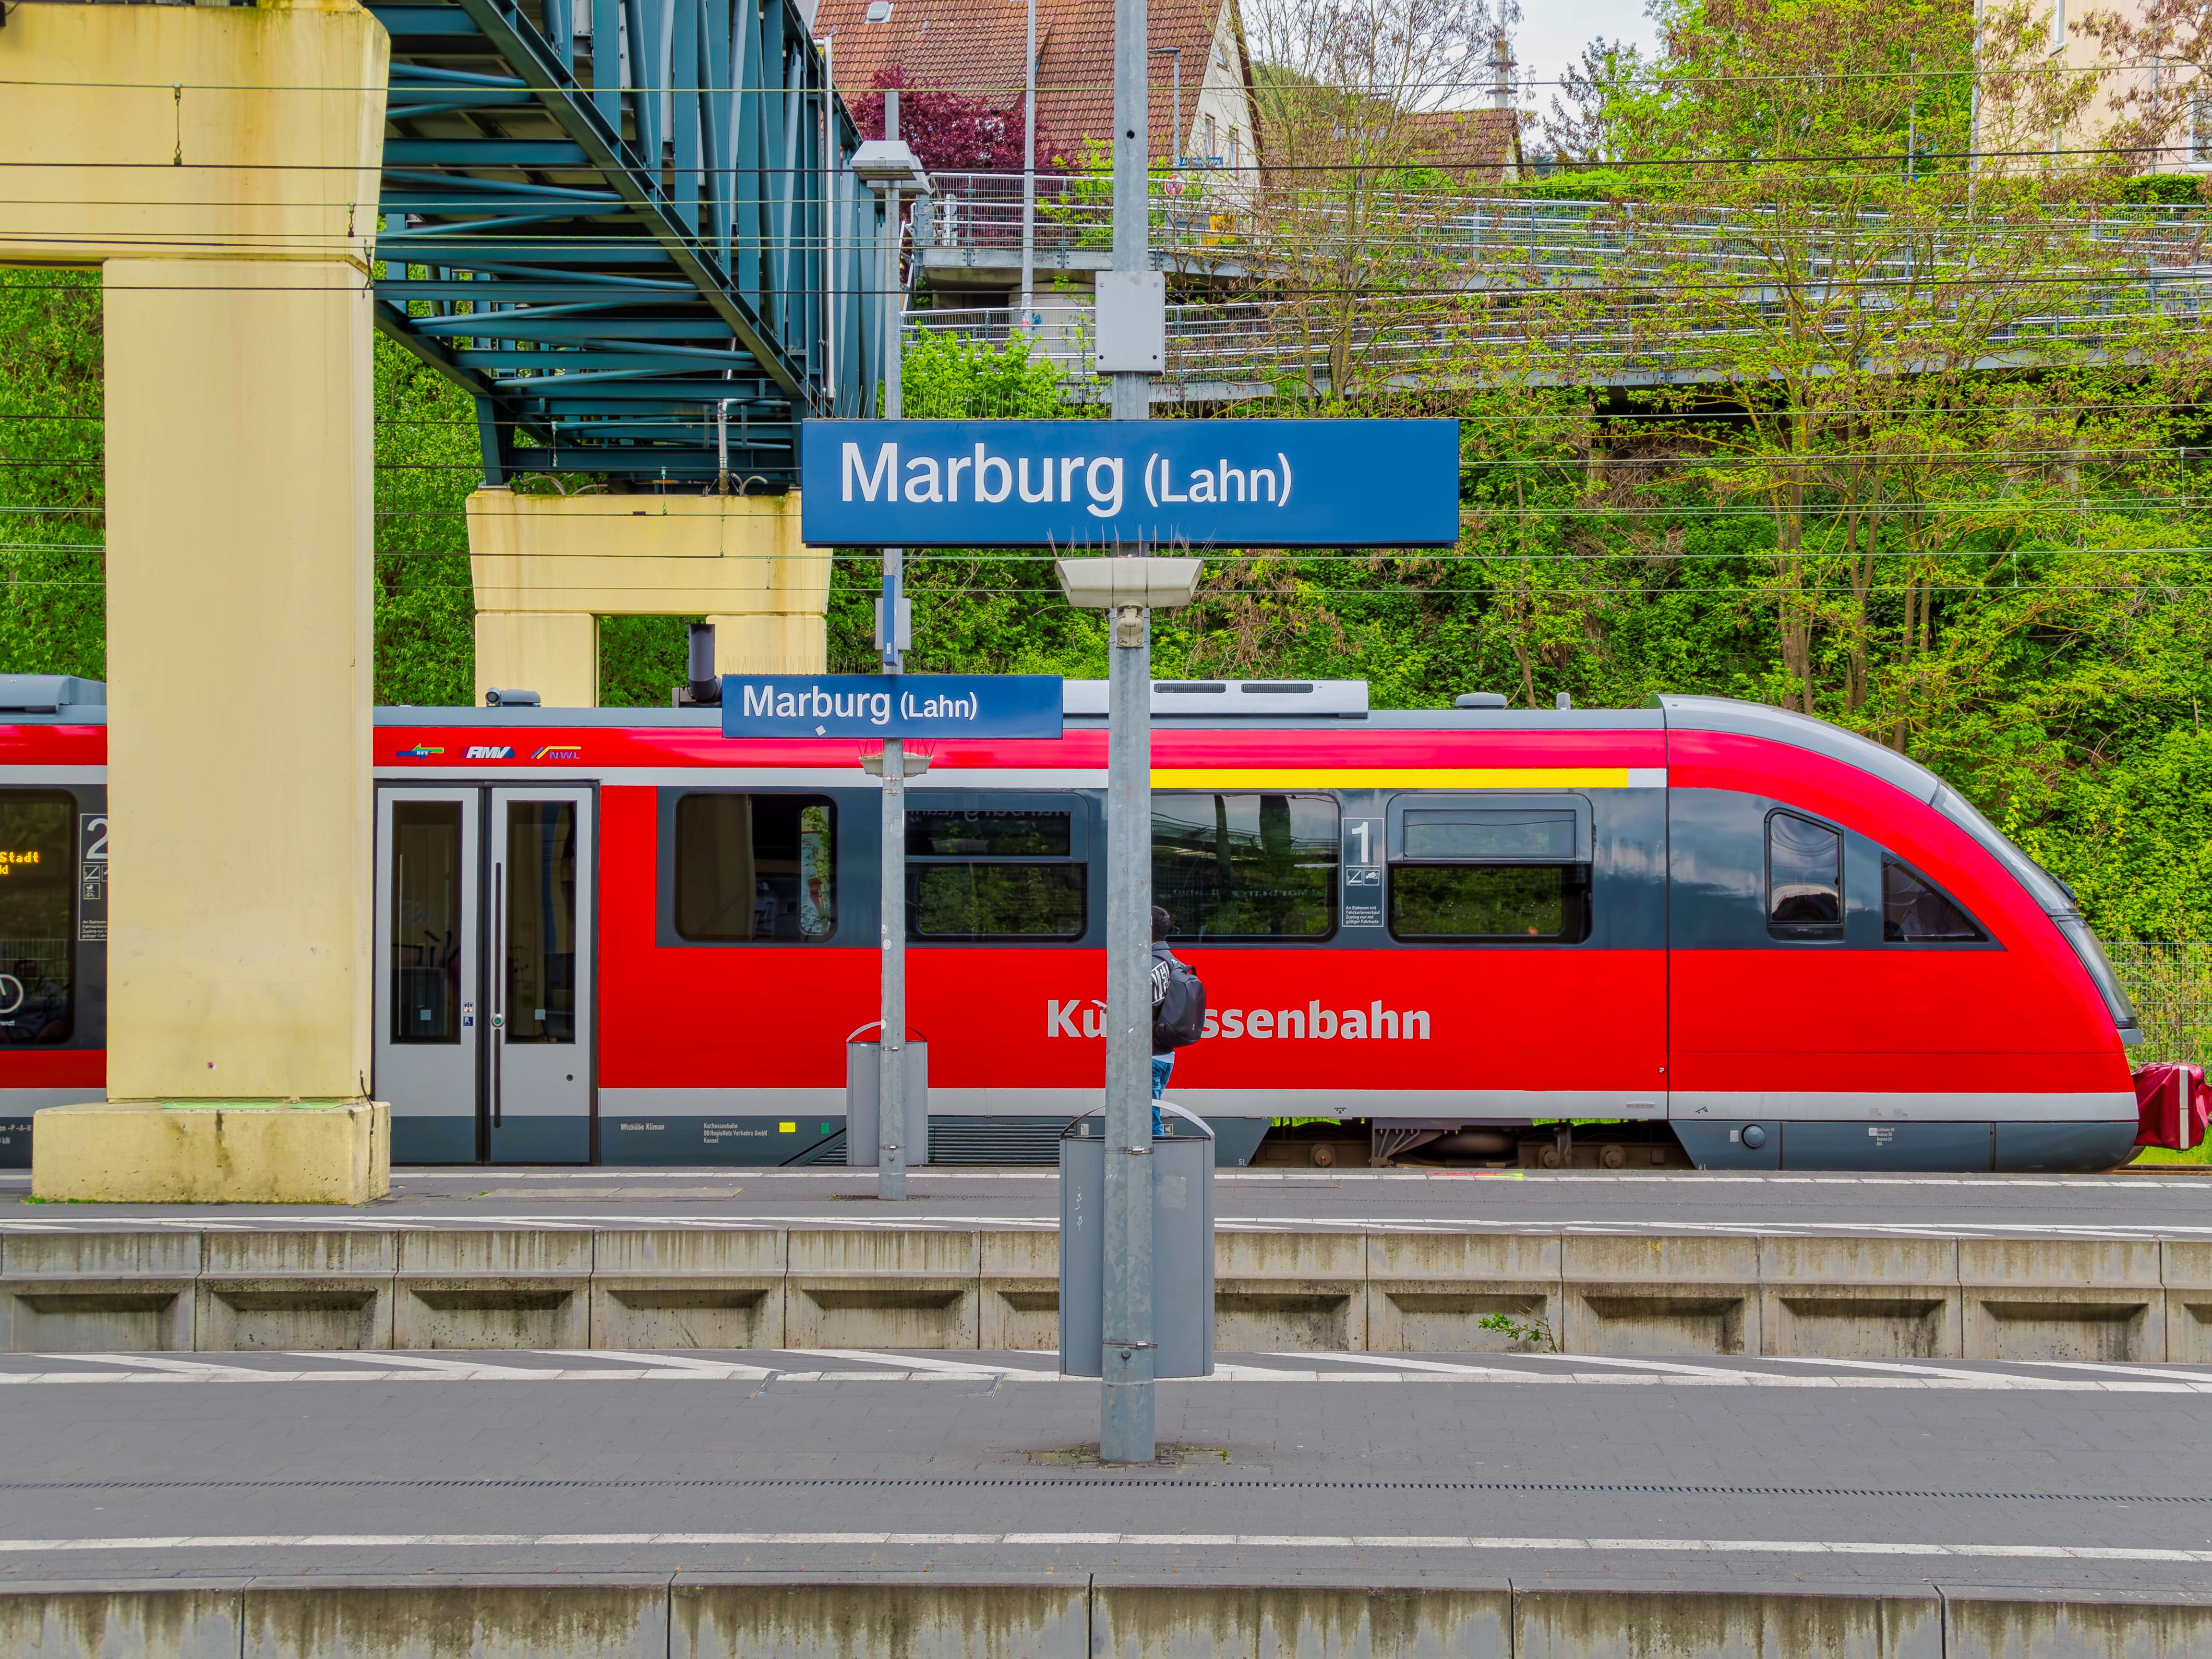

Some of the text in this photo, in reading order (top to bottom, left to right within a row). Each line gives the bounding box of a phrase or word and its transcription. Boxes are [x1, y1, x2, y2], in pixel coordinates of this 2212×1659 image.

[841, 441, 1293, 518] Marburg (Lahn)
[743, 685, 978, 725] Marburg (Lahn)
[466, 745, 511, 758] RMV
[549, 751, 581, 759] NWL
[0, 852, 39, 863] Stadt
[86, 817, 108, 859] 2
[1351, 821, 1369, 863] 1
[1047, 999, 1431, 1040] Kussenbahn
[1238, 1158, 1246, 1166] 5L
